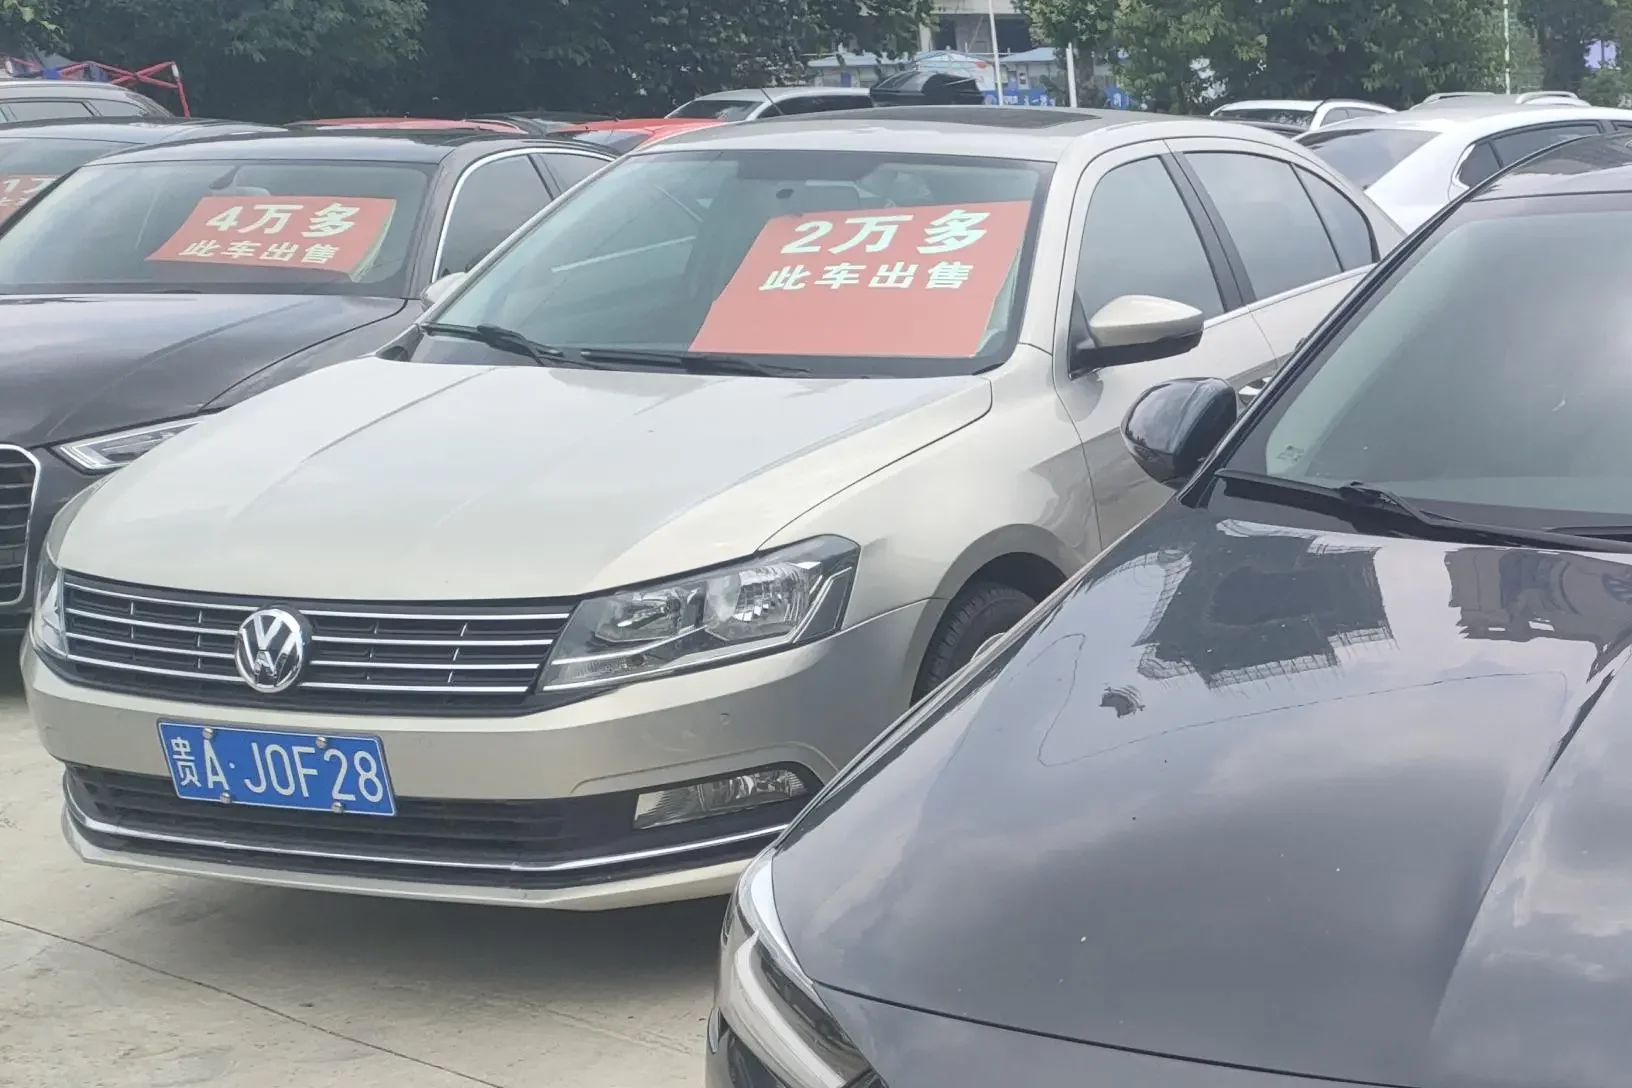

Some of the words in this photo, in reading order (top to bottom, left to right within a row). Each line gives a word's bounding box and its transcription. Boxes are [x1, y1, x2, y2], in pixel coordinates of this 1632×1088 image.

[205, 202, 361, 238] 4万多
[780, 208, 991, 254] 2万多
[178, 239, 340, 264] 此车出售
[758, 260, 975, 290] 此车出售
